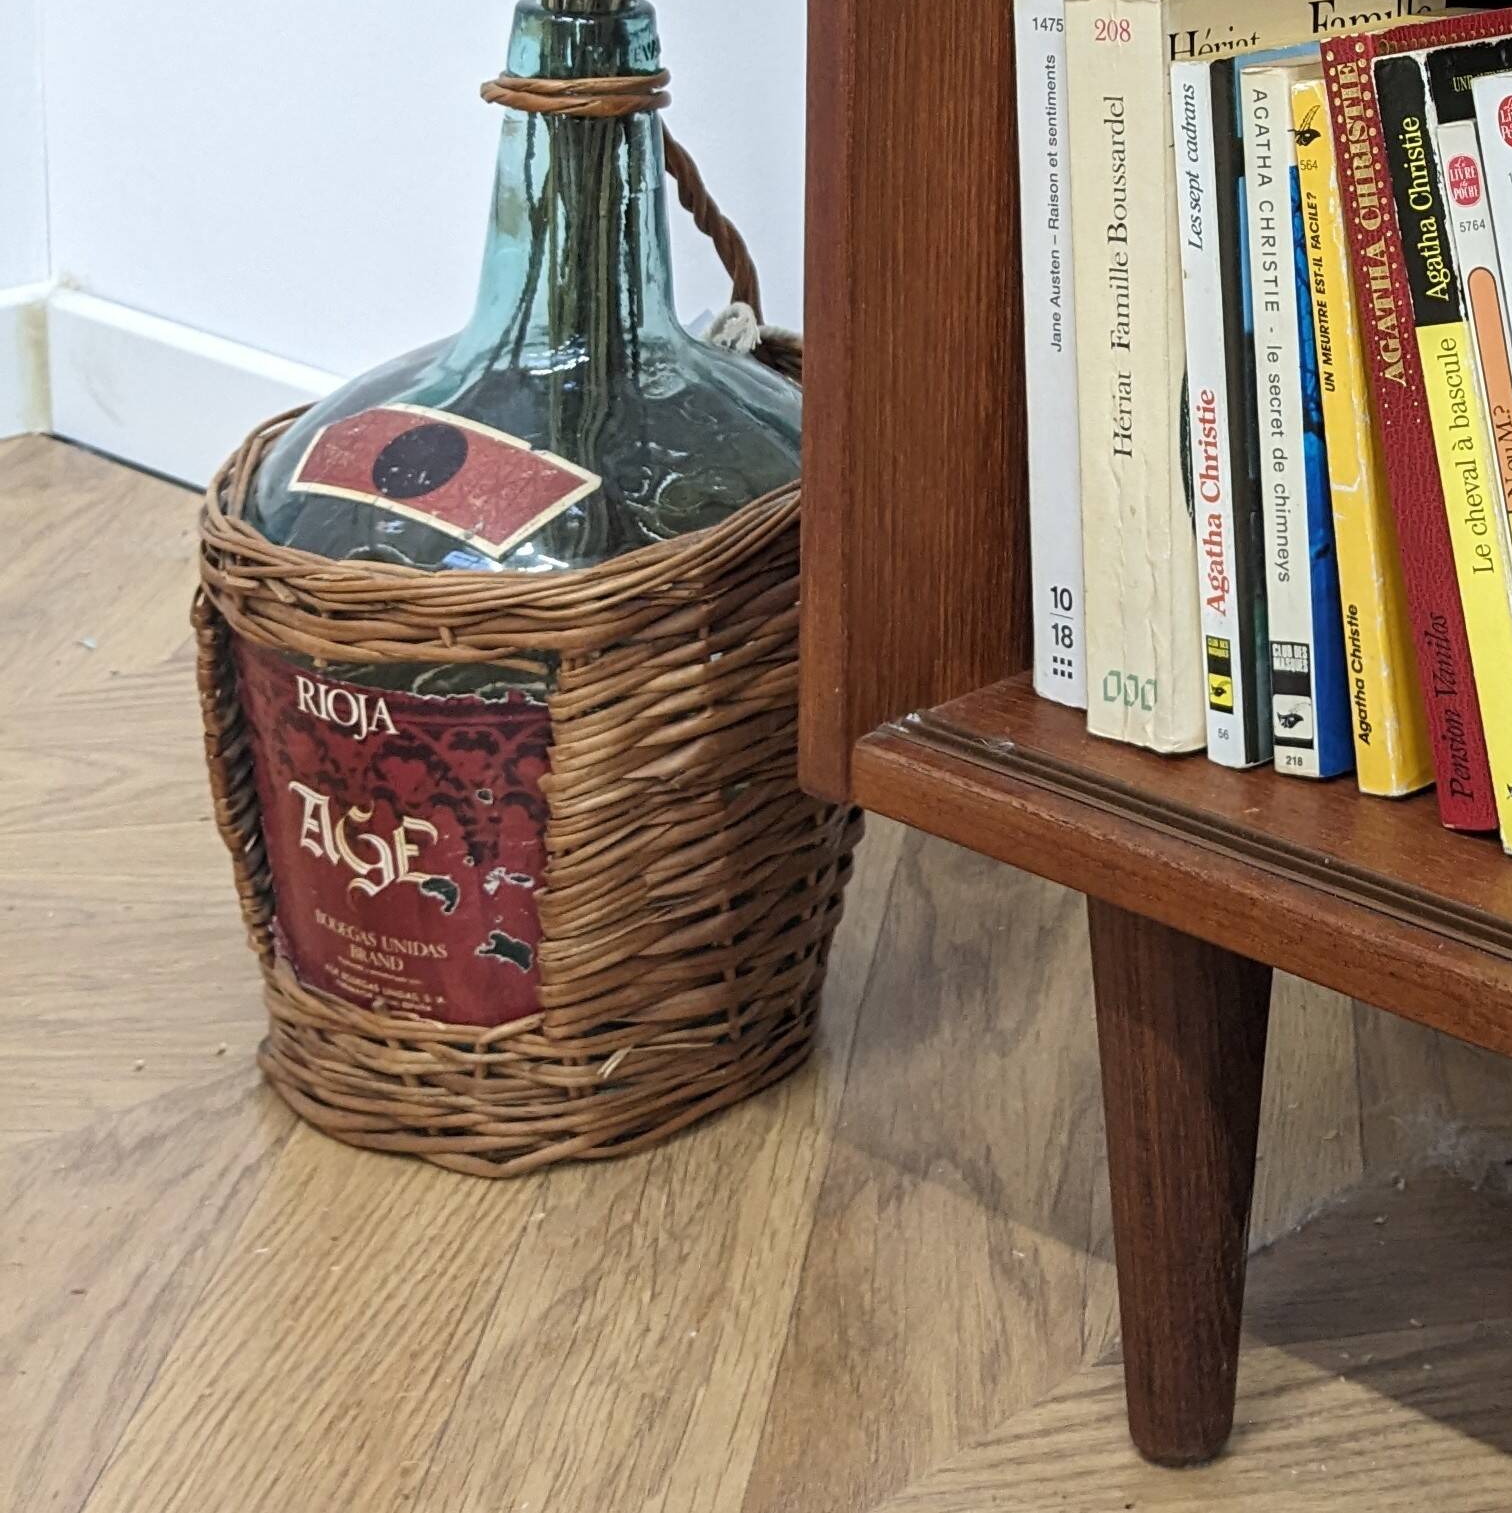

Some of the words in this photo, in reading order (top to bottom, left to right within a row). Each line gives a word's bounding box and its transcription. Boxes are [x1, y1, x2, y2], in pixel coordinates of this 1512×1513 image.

[1032, 17, 1064, 32] 1475
[1094, 19, 1132, 43] 208
[1046, 54, 1057, 147] sentiments
[1180, 84, 1199, 163] cadrans
[1049, 151, 1058, 169] et
[1252, 88, 1272, 188] AGATHA
[1300, 159, 1318, 172] 564
[1336, 62, 1382, 231] CHRISTIE
[1403, 116, 1433, 210] Christie
[1048, 173, 1059, 230] Raison
[1103, 95, 1129, 246] Boussardel
[1182, 172, 1205, 210] sept
[1450, 166, 1477, 181] LIVRE
[1453, 185, 1478, 200] POCHE
[1187, 213, 1204, 251] Les
[1305, 191, 1321, 250] FACILE?
[1459, 218, 1487, 233] 5764
[1050, 250, 1062, 307] Austen
[1259, 200, 1279, 313] CHRISTIE
[1311, 255, 1326, 296] EST-IL
[1414, 217, 1451, 301] Agatha
[1049, 310, 1063, 353] Jane
[1108, 251, 1131, 353] Famille
[1317, 300, 1334, 365] MEURTRE
[1362, 236, 1407, 387] AGATHA
[1266, 344, 1283, 362] le
[1323, 369, 1335, 393] UN
[1112, 372, 1133, 459] Hériat
[1268, 372, 1284, 439] secret
[1436, 337, 1470, 433] bascule
[1197, 389, 1221, 503] Christie
[1273, 447, 1286, 474] de
[1452, 436, 1474, 451] à
[1455, 458, 1490, 536] cheval
[1273, 481, 1291, 583] chimneys
[1473, 543, 1495, 576] Le
[1206, 512, 1230, 617] Agatha
[1050, 586, 1072, 612] 10
[1052, 624, 1073, 648] 18
[1347, 603, 1363, 675] Christie
[1430, 612, 1457, 698] Vanilos
[297, 675, 399, 740] RIOJA
[1218, 728, 1229, 740] 56
[1352, 678, 1371, 746] Agatha
[1286, 756, 1303, 766] 218
[1444, 709, 1475, 801] Pension
[288, 781, 450, 899] AGE
[381, 935, 448, 958] UNIDAS
